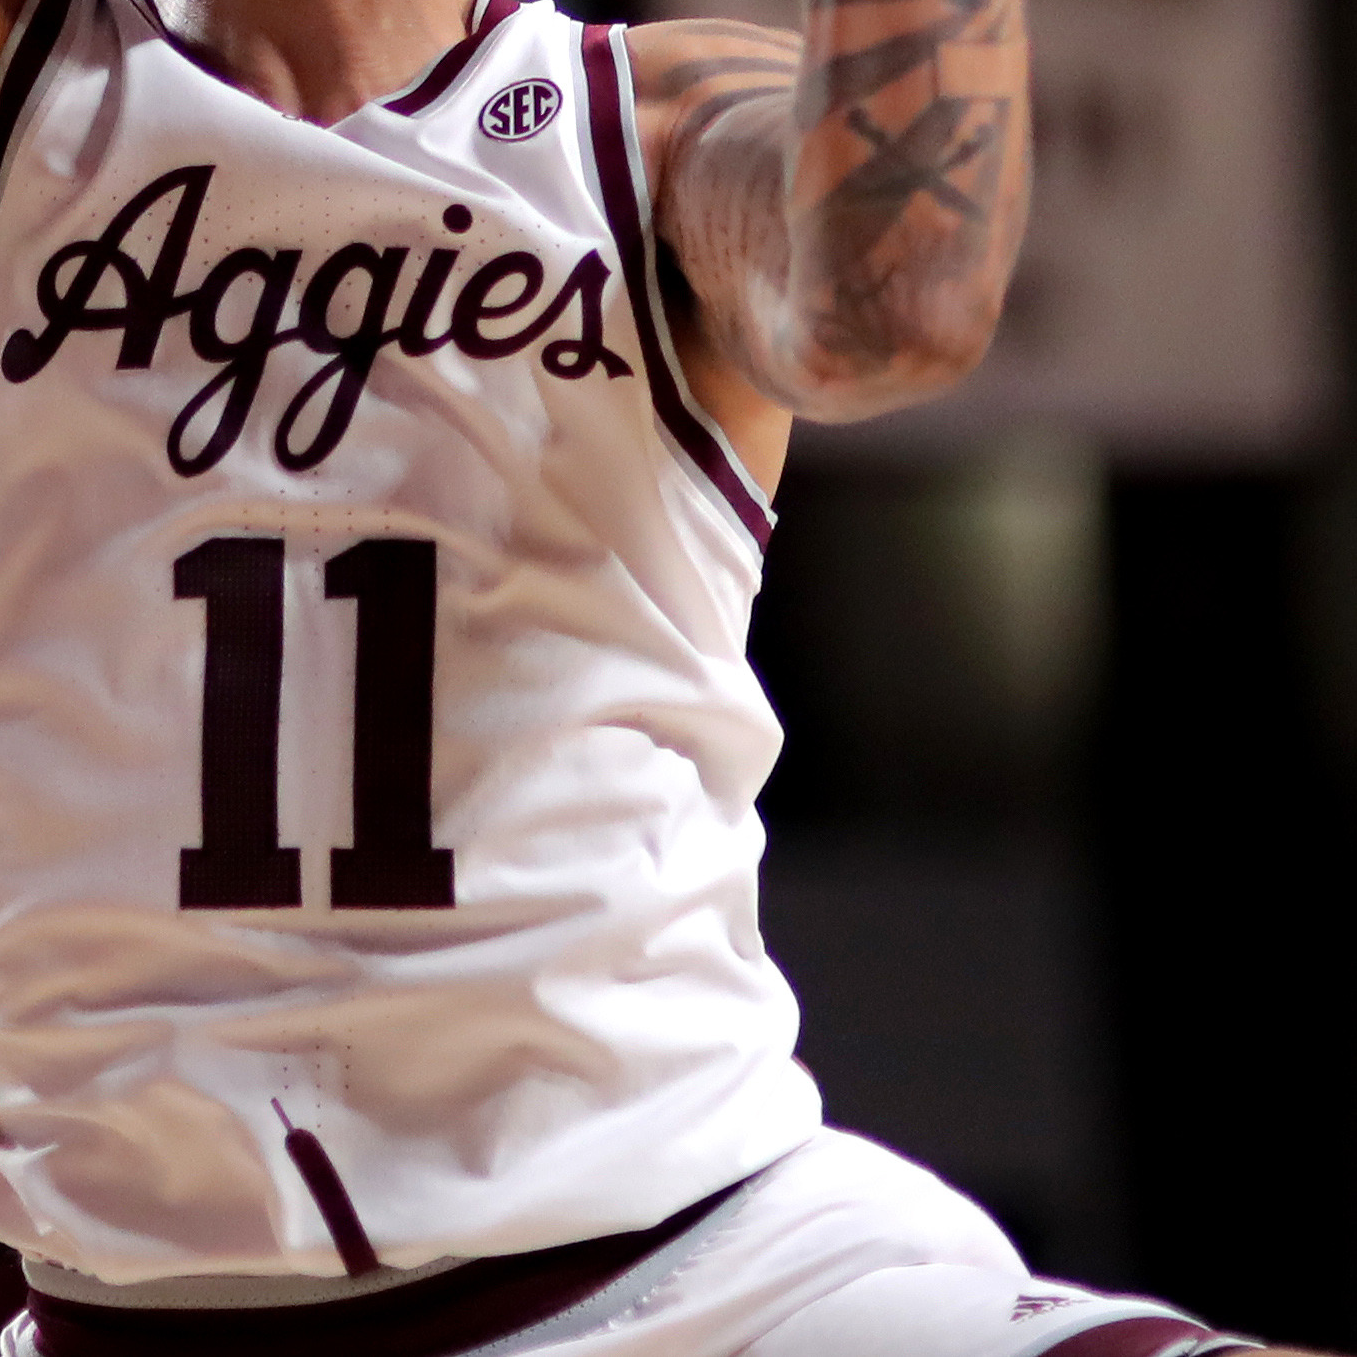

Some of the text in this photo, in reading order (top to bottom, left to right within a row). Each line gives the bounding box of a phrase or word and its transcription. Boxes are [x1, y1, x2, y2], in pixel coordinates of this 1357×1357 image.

[489, 84, 554, 136] SEC
[0, 164, 634, 478] Aggies
[173, 537, 457, 910] 11
